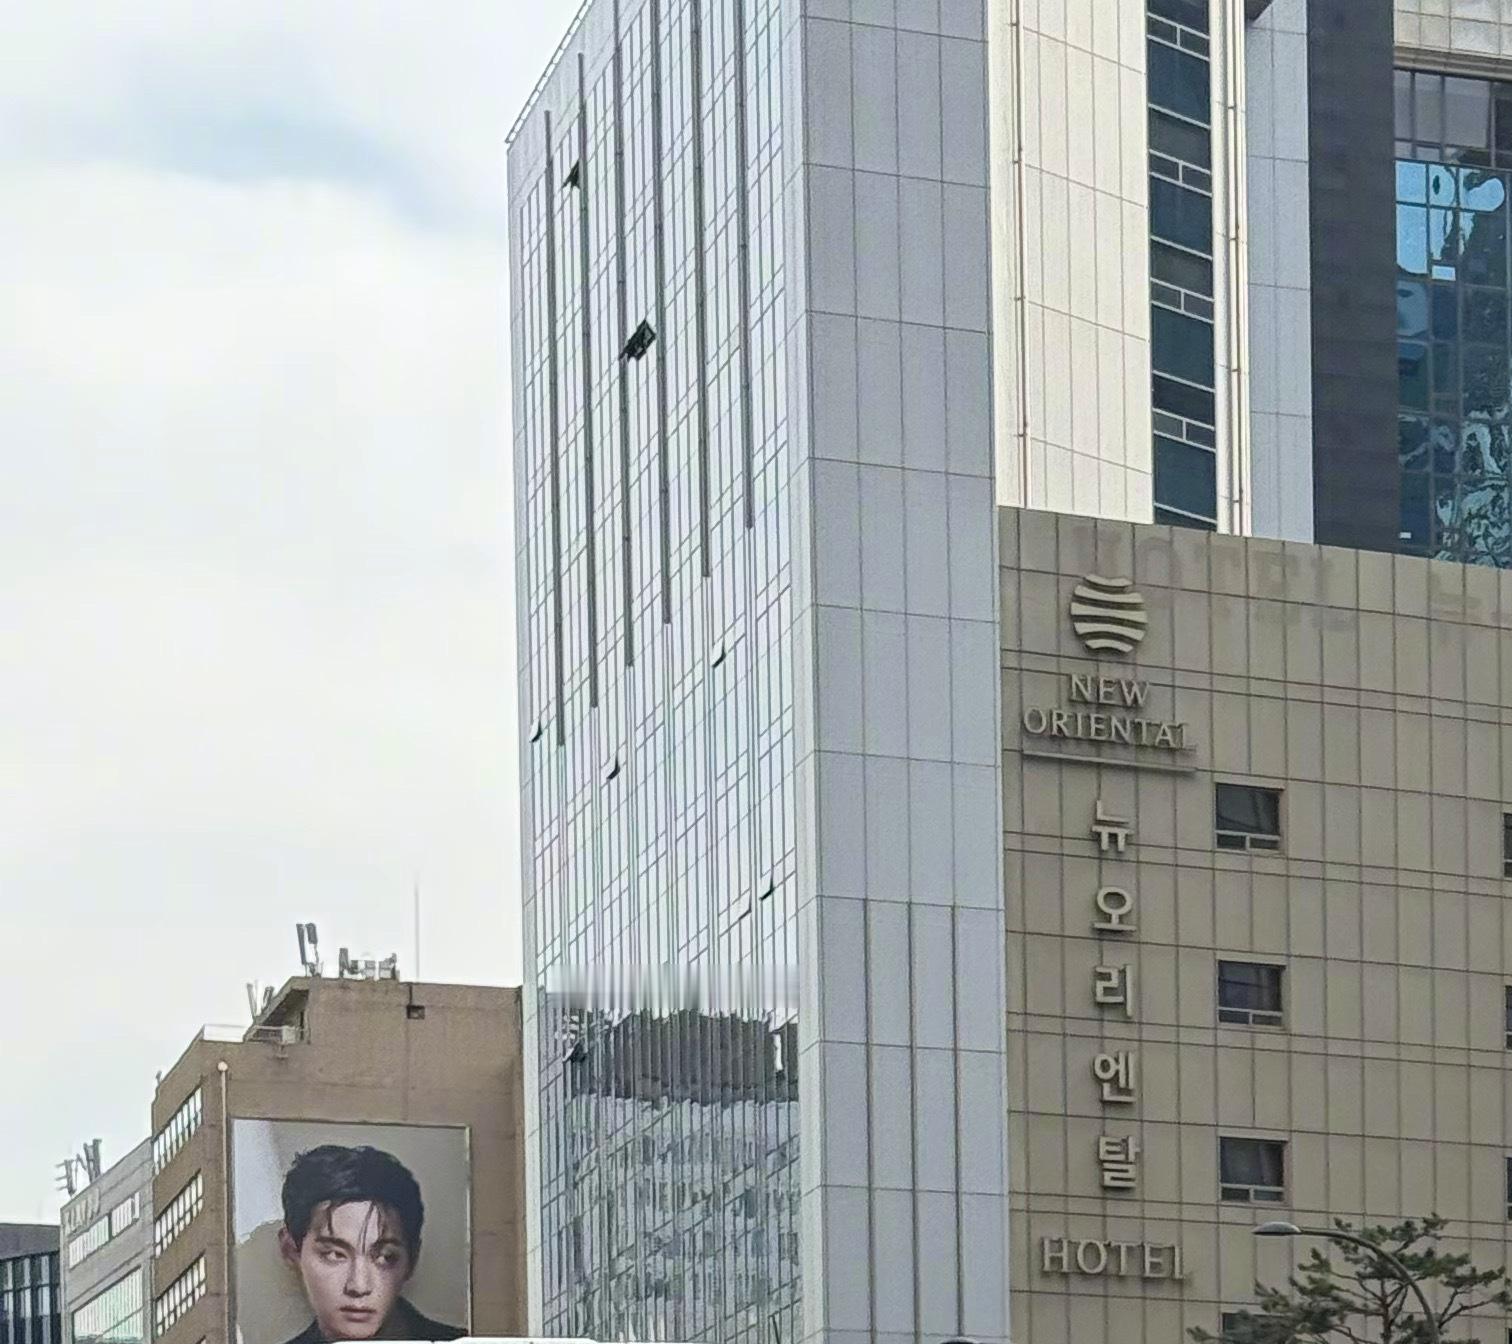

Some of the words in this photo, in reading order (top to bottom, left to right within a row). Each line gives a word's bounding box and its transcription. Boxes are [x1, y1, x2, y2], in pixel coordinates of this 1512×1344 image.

[1069, 673, 1150, 707] NEW
[1023, 706, 1197, 752] ORIENTAL
[1092, 799, 1141, 1190] 뉴오리엔탈
[1039, 1235, 1188, 1281] HOTEL
